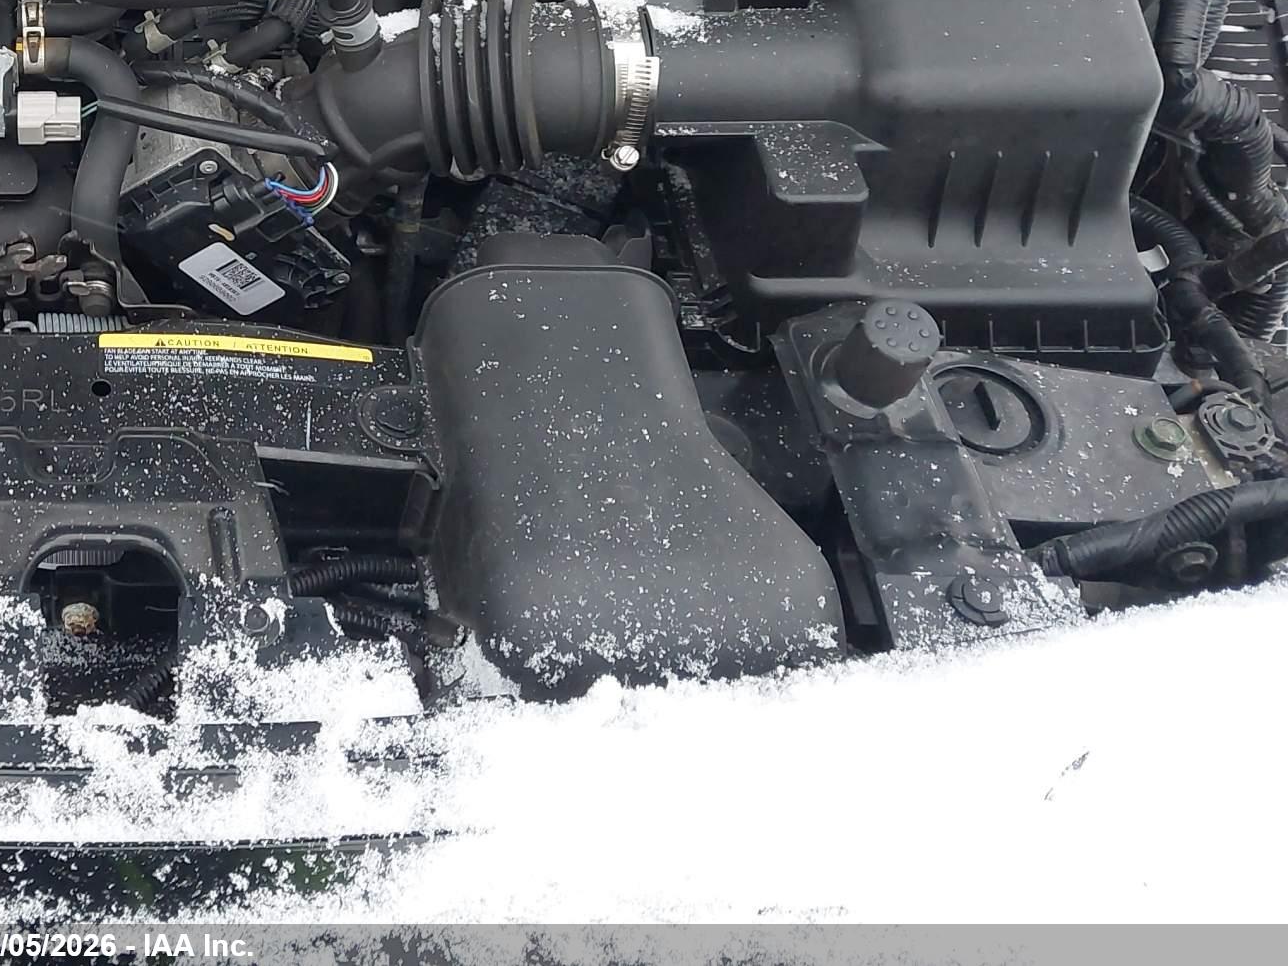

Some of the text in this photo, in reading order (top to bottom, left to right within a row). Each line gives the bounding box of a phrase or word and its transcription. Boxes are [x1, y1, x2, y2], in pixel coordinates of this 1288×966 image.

[167, 338, 220, 347] CAUTION
[246, 343, 308, 354] ATTENTION
[0, 388, 68, 413] 5RL
